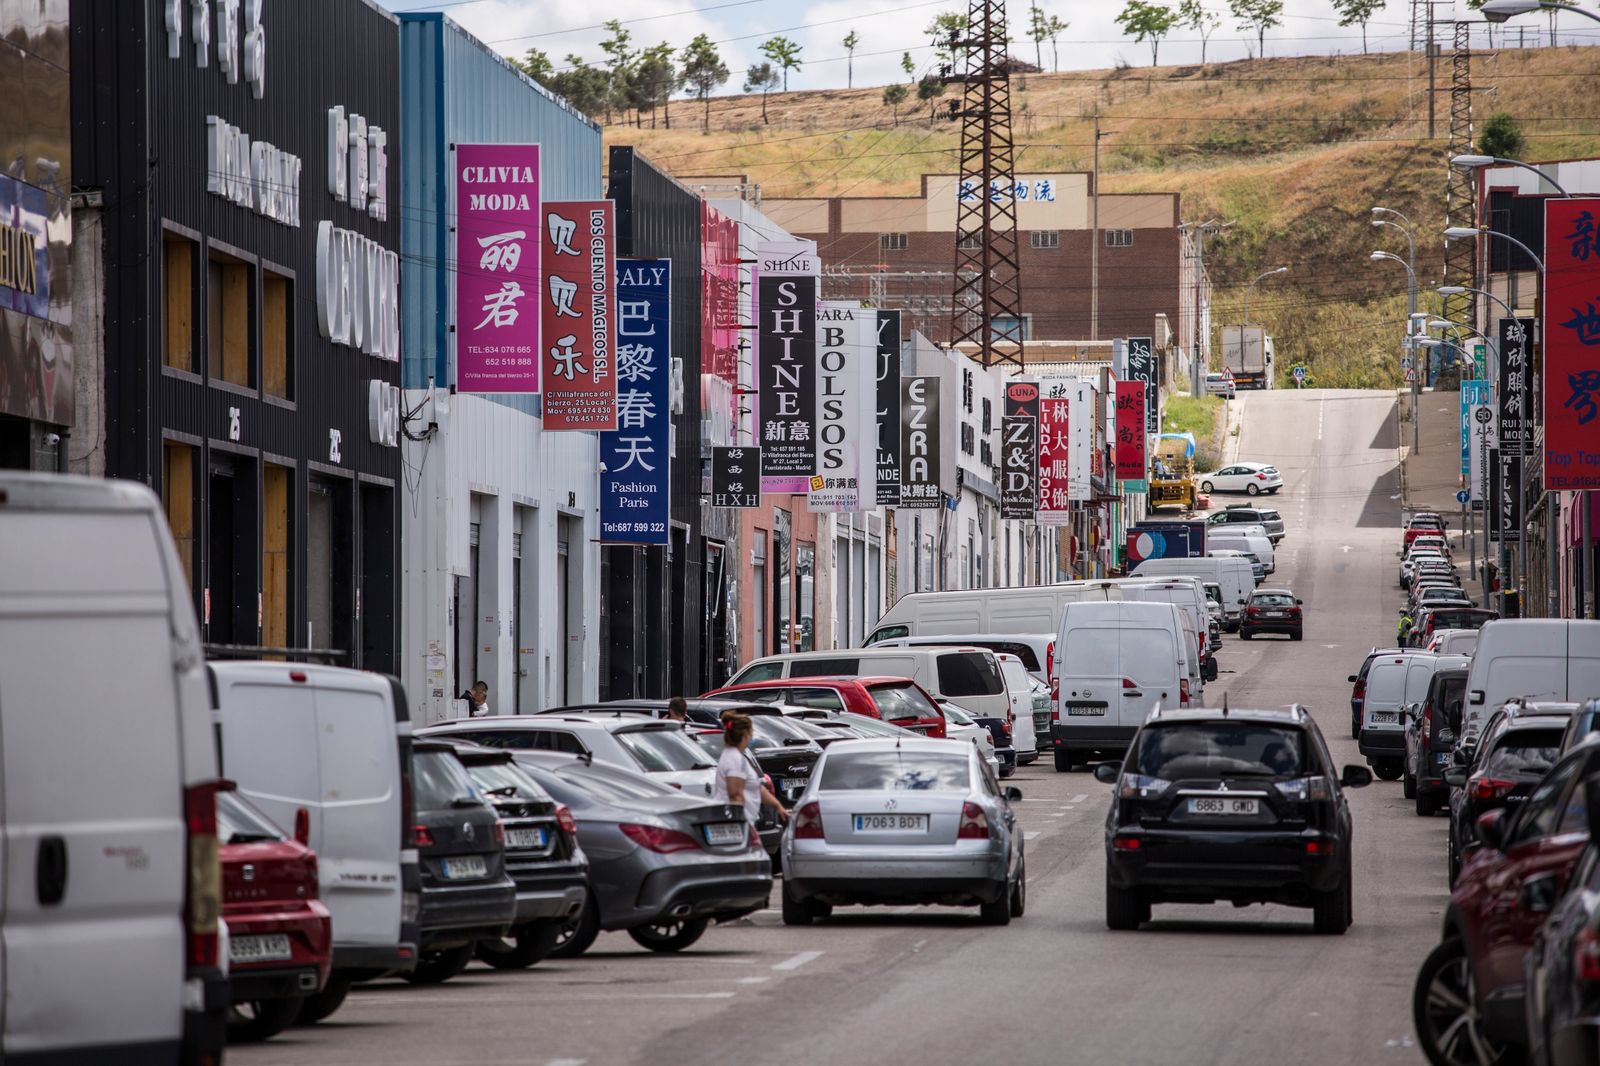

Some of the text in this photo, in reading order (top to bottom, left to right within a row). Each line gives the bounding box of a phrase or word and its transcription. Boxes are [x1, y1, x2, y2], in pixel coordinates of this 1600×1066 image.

[462, 166, 534, 184] CLIVIA
[469, 194, 530, 211] MODA
[590, 209, 605, 236] LOS
[590, 237, 606, 295] CUENTO
[764, 260, 811, 272] SHINE
[473, 230, 527, 331] 丽君
[591, 295, 607, 359] MAGICOS
[468, 346, 531, 354] TEL:634 076 665
[771, 282, 804, 416] SHINE
[485, 358, 532, 366] 652 518 888
[557, 390, 598, 399] Villafranca
[612, 300, 657, 473] 巴黎春天
[1009, 388, 1036, 397] LUNA
[820, 327, 846, 469] BOLSOS
[764, 420, 811, 442] 新意
[1501, 420, 1516, 428] RUI
[1006, 422, 1030, 492] Z&D
[1039, 402, 1051, 510] LINDA MODA
[1052, 401, 1068, 509] 林大服饰
[1548, 449, 1573, 468] Top
[610, 482, 657, 493] Fashion
[618, 497, 649, 508] Paris
[603, 522, 665, 533] Tel:687 599 322
[1196, 800, 1224, 811] 6863
[864, 816, 922, 828] 7063 BDT
